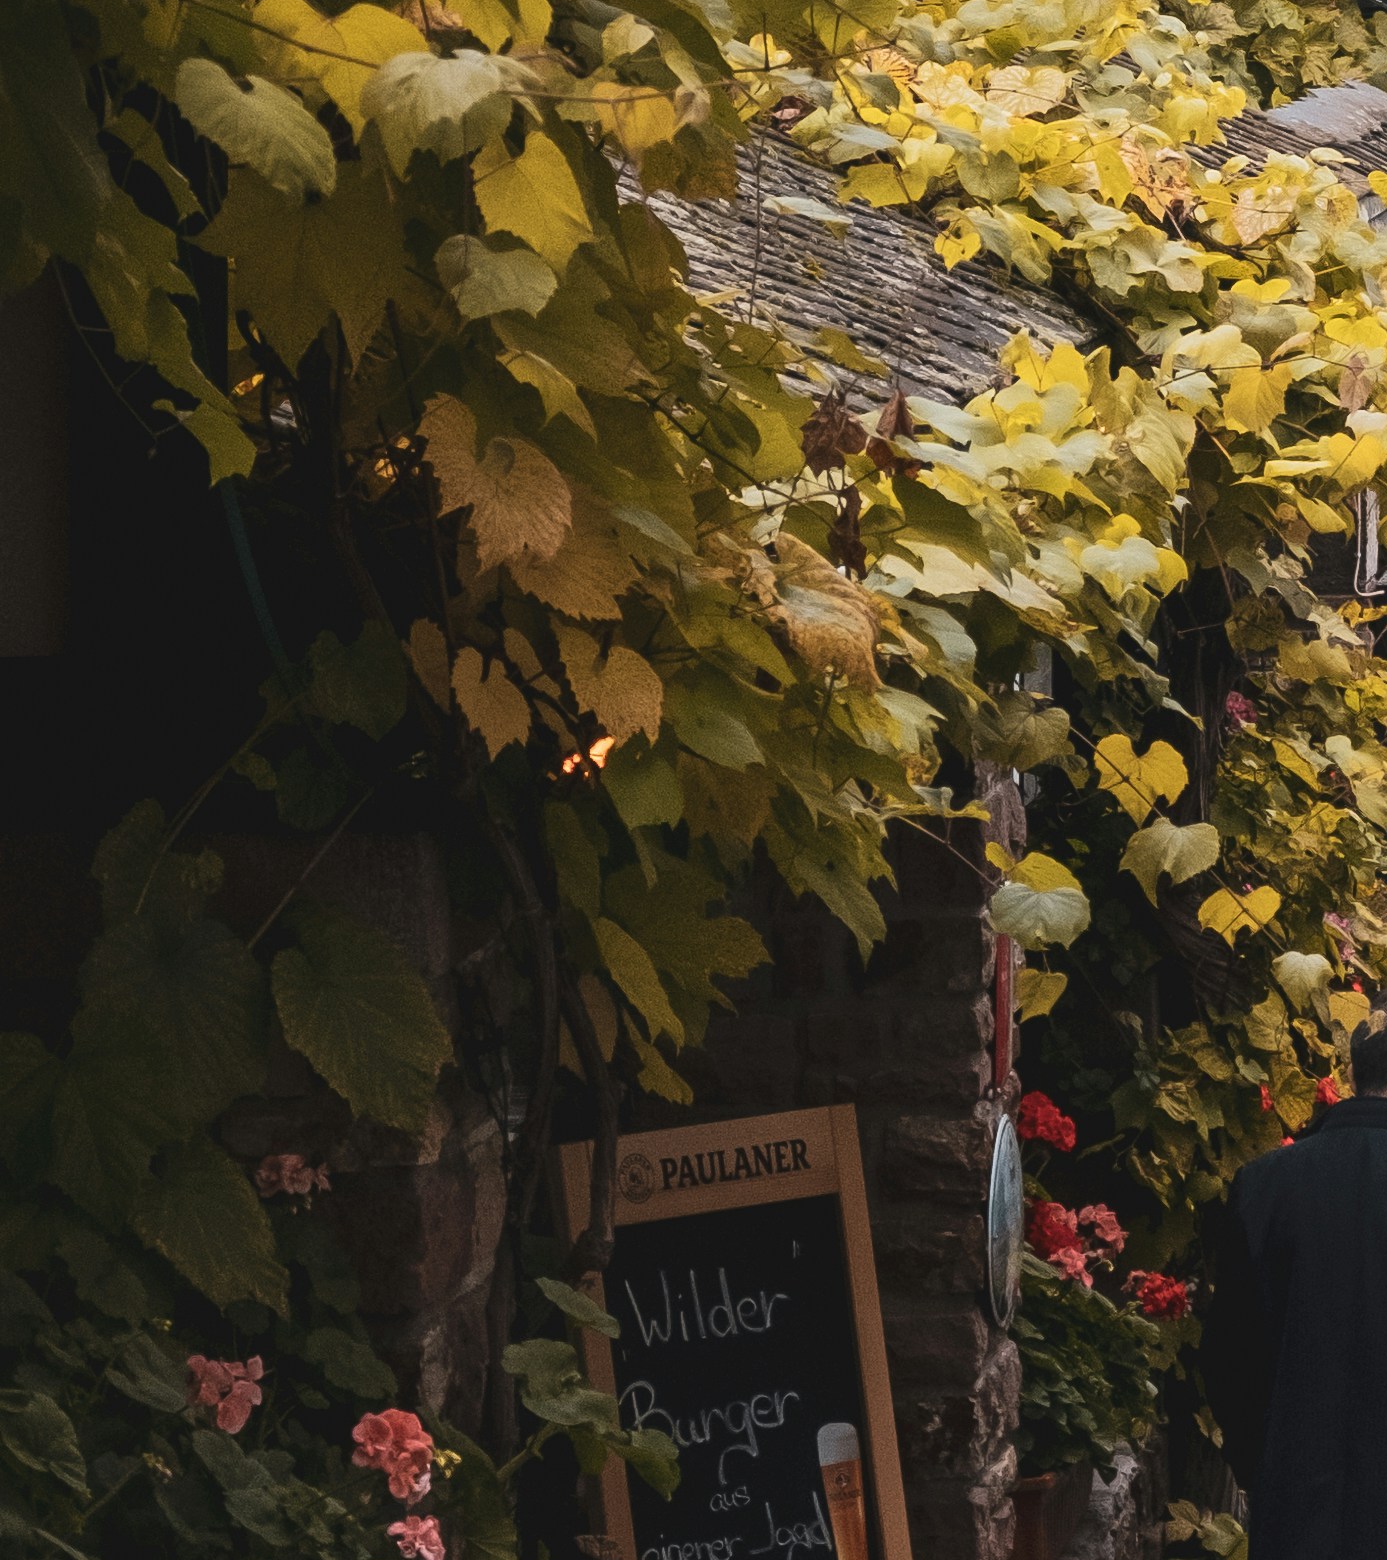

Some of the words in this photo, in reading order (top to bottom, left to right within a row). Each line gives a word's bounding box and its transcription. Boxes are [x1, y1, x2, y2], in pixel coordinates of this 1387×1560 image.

[659, 1138, 811, 1191] PAULANER
[619, 1380, 800, 1486] Burger
[709, 1485, 752, 1513] aus
